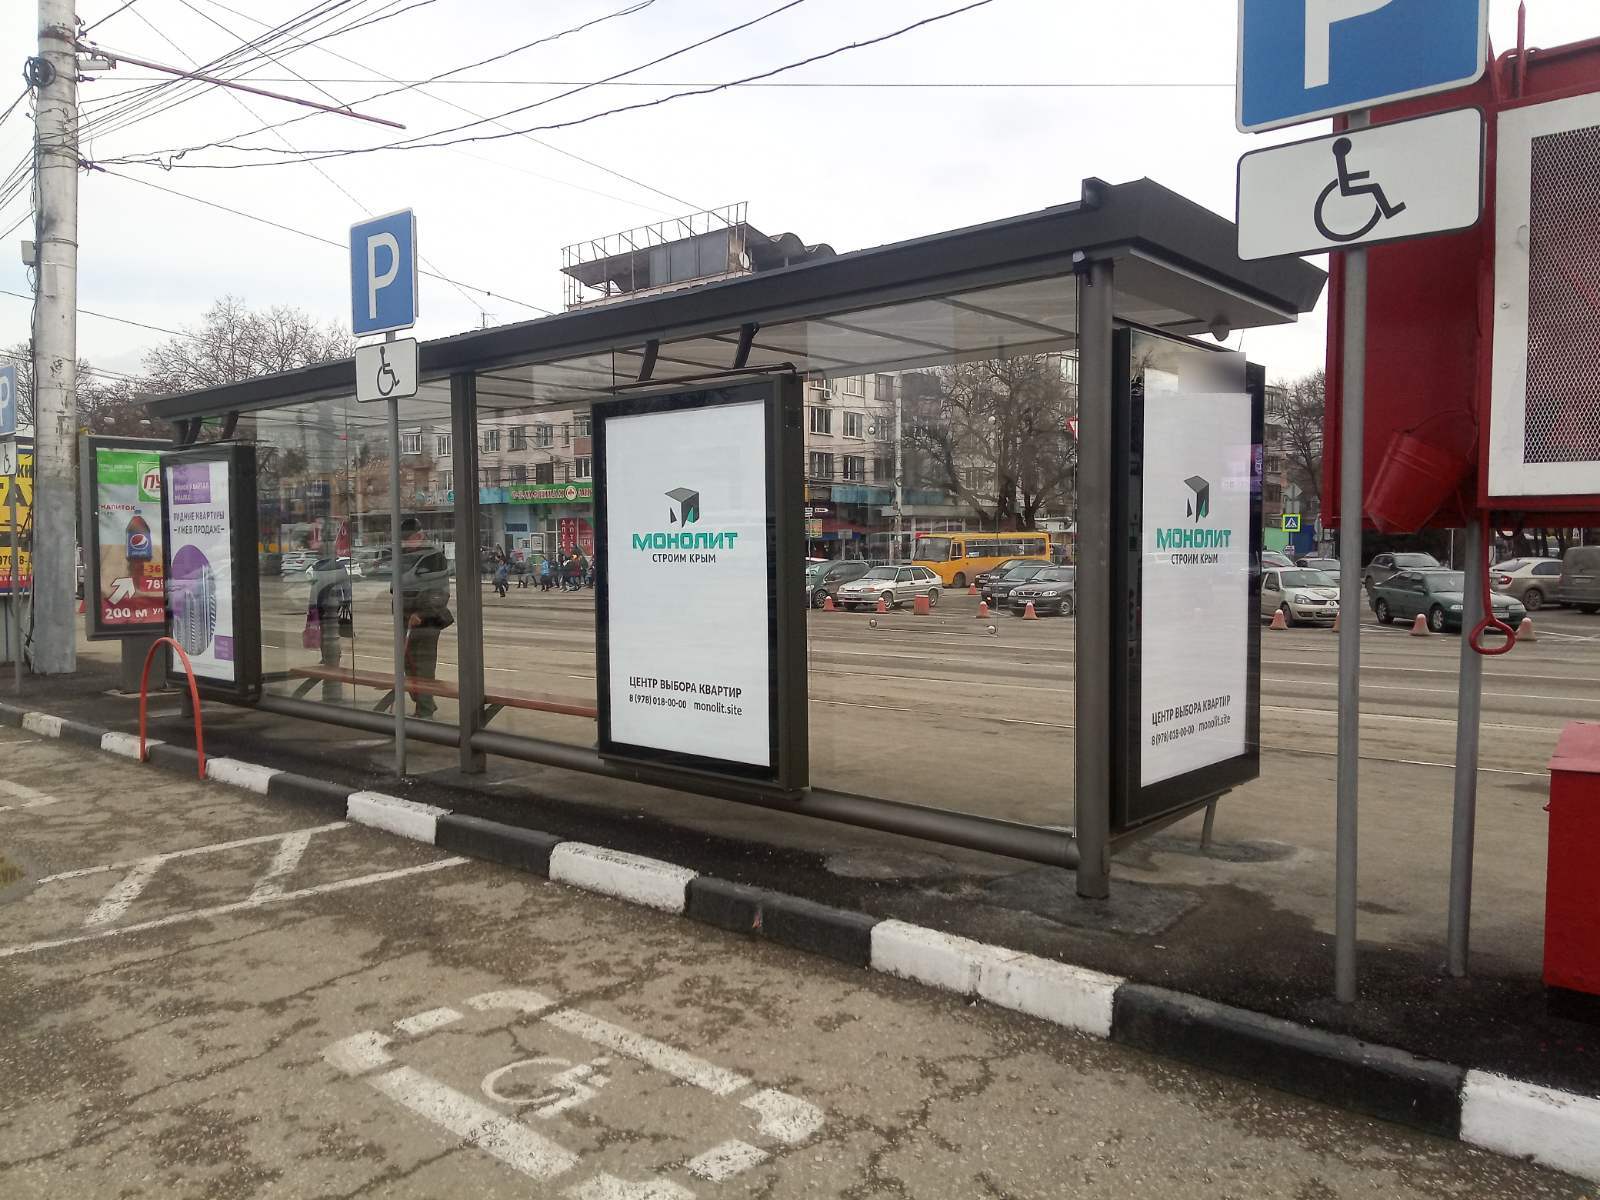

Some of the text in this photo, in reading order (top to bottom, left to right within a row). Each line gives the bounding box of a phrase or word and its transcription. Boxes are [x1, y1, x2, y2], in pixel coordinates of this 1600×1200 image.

[367, 232, 400, 320] P
[632, 532, 738, 551] МОНОЛИТ
[1156, 527, 1231, 551] МОНОЛИТ
[652, 553, 717, 563] СТРОИМ КРЫМ
[1171, 553, 1218, 565] СТРОИМ КРЫМ
[105, 607, 131, 620] 200
[629, 676, 742, 699] ЦЕНТР ВЫБОРА КВАРТИР
[629, 693, 742, 716] 8 (978) 018-00-00 monolit.site
[1152, 695, 1231, 726] ЦЕНТР ВЫБОРА КВАРТИР
[1198, 714, 1231, 732] monolit.site
